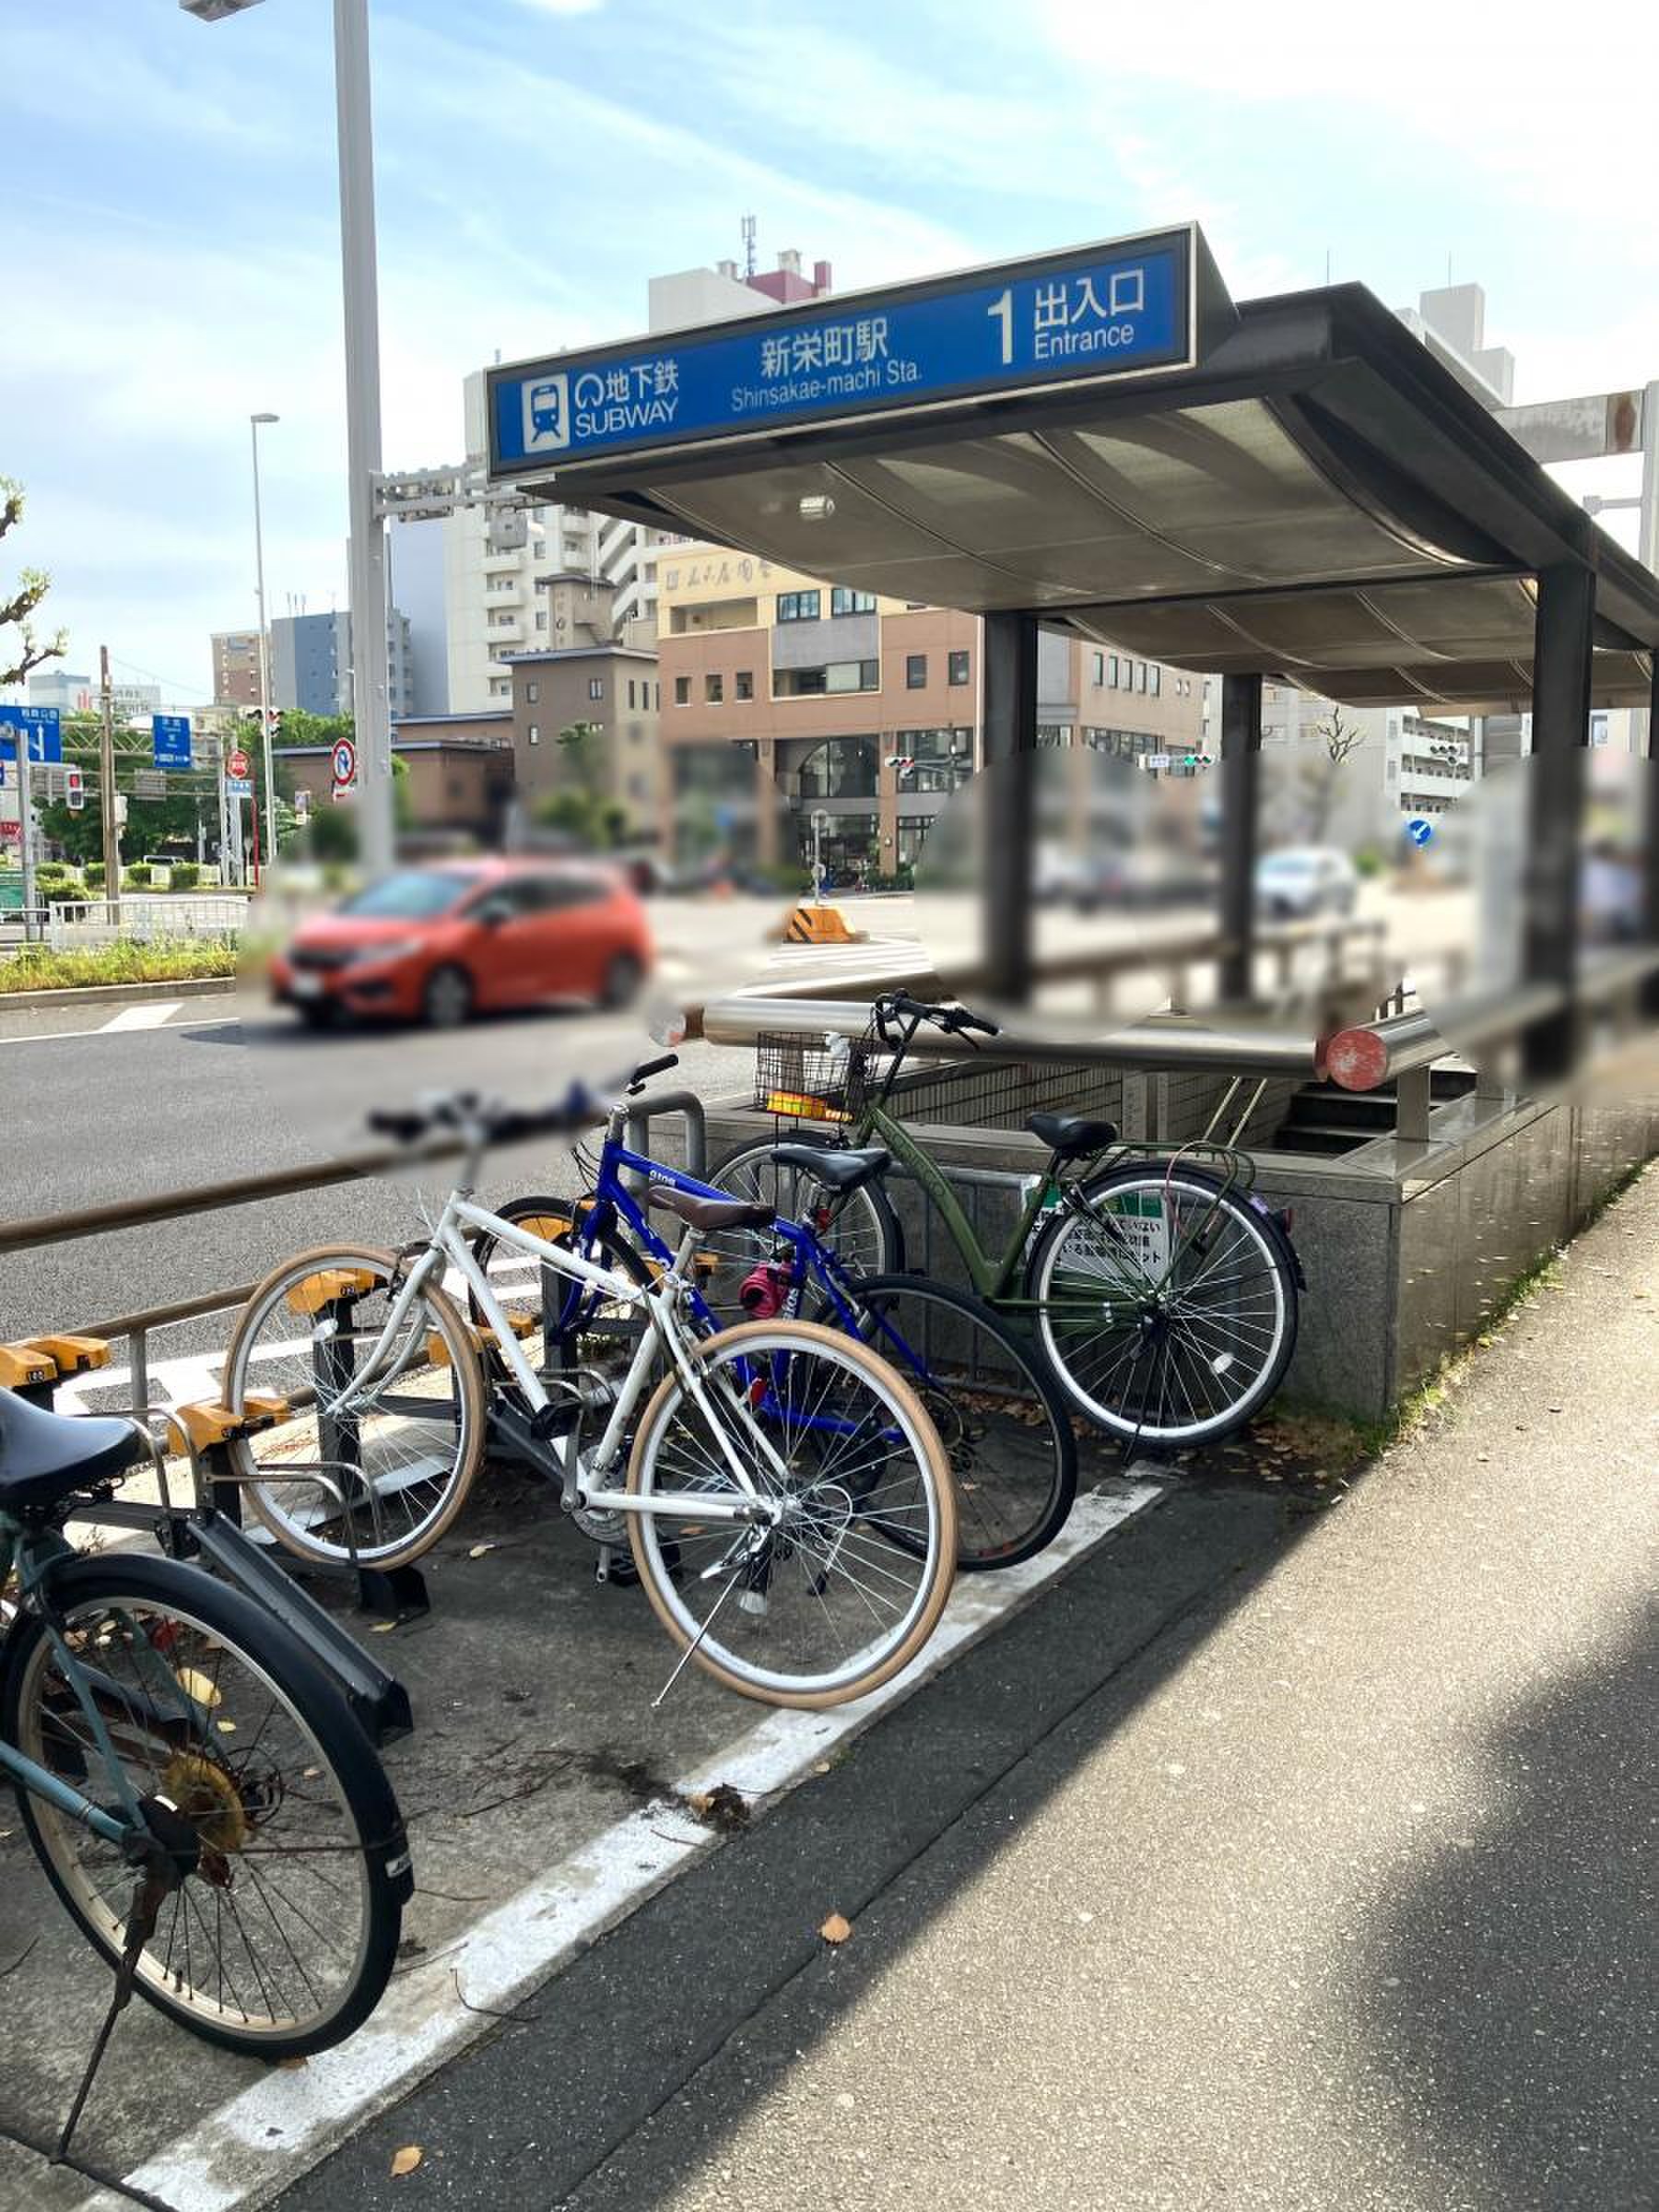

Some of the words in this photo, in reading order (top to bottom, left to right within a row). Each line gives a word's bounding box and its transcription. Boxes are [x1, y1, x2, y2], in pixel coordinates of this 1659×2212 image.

[1034, 268, 1145, 331] 出入口
[760, 317, 888, 379] 新栄町駅
[987, 288, 1013, 365] 1
[1034, 324, 1135, 360] Entrance
[605, 359, 679, 403] 地下鉄
[731, 362, 881, 412] Shinsakae-machi
[886, 359, 923, 385] Sta.
[574, 397, 679, 439] SUBWAY
